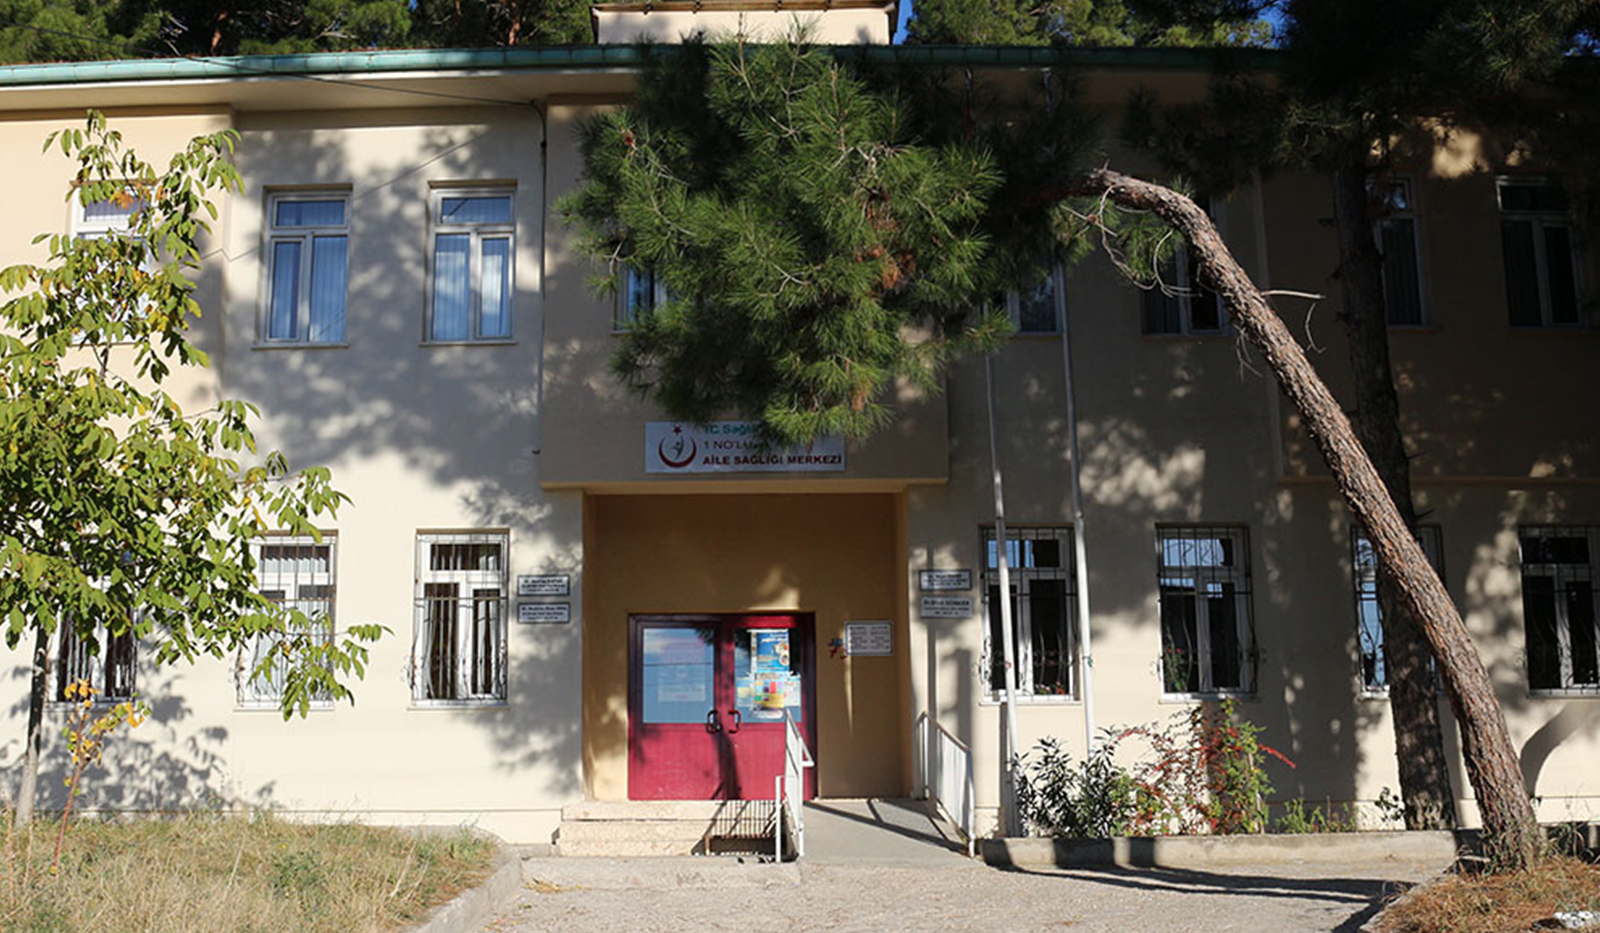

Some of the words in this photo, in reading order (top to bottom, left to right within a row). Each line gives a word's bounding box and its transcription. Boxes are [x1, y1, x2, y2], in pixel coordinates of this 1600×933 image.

[704, 440, 709, 450] 1
[703, 454, 731, 465] AİLE
[735, 454, 784, 465] SAĞLIĞI
[788, 453, 842, 464] MERKEZİ
